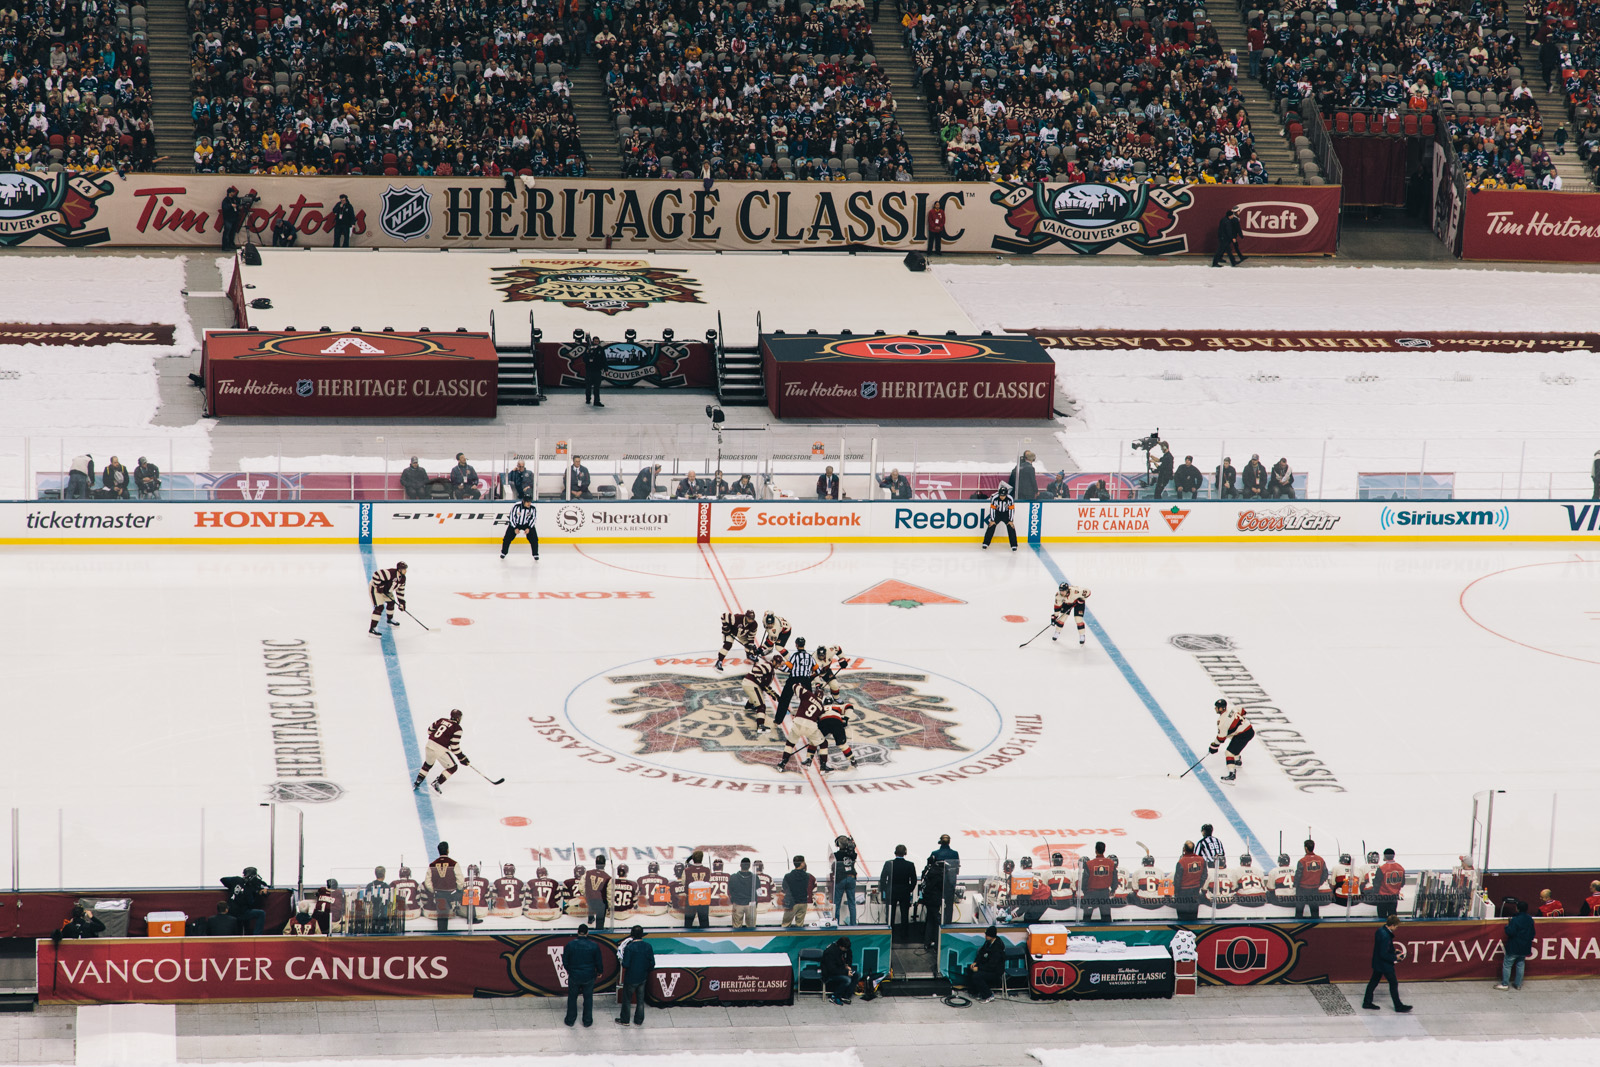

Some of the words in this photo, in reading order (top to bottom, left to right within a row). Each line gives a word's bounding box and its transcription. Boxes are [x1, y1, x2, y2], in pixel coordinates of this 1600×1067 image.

[75, 180, 91, 195] 14
[1009, 187, 1028, 205] 20
[1154, 191, 1171, 206] 14
[40, 211, 59, 224] BC
[133, 187, 210, 234] Tim
[390, 202, 423, 229] NHL
[443, 187, 722, 242] HERITAGE
[738, 189, 966, 245] CLASSIC
[1245, 209, 1298, 230] Kraft
[1487, 211, 1523, 236] Tim
[1525, 211, 1600, 238] Hortons
[1042, 221, 1117, 241] VANCOUVER
[1120, 221, 1138, 234] BC
[0, 331, 100, 341] Horton
[103, 331, 157, 341] Tim
[1034, 336, 1193, 348] CLASSIC
[1200, 337, 1392, 349] HERITAGE
[1436, 338, 1536, 349] Hortons
[1540, 338, 1594, 349] Tim
[217, 379, 242, 396] Tim
[243, 379, 293, 396] Hortons
[317, 379, 408, 397] HERITAGE
[412, 379, 488, 397] CLASSIC
[784, 381, 808, 397] Tim
[809, 381, 858, 398] Hortons
[881, 381, 969, 399] HERITAGE
[973, 381, 1047, 400] CLASSIC
[26, 511, 155, 529] ticketmaster
[194, 511, 334, 528] HONDA
[361, 503, 371, 537] Reebok
[591, 511, 669, 524] Sheraton
[699, 503, 709, 537] Reebok
[757, 511, 862, 527] Scotiabank
[894, 508, 991, 530] Reebok
[1030, 502, 1040, 536] Reebok
[1077, 507, 1098, 519] WE
[1100, 507, 1121, 519] ALL
[1123, 507, 1151, 519] PLAY
[1237, 510, 1285, 532] Coors
[1284, 516, 1341, 531] LIGHT
[1077, 520, 1100, 531] FOR
[1102, 520, 1149, 531] CANADA
[453, 590, 654, 600] HONDA
[262, 638, 313, 698] CLASSIC
[805, 704, 818, 717] 9
[433, 725, 448, 738] 8
[1014, 713, 1043, 736] TIM
[1196, 654, 1293, 726] HERITAGE
[1256, 727, 1347, 794] CLASSIC
[268, 700, 325, 778] HERITAGE
[528, 714, 617, 765] CLASSIC
[918, 736, 1038, 786] HORTONS
[617, 762, 803, 795] HERITAGE
[832, 779, 915, 795] NHL
[961, 828, 1128, 839] Scotiabank
[529, 846, 695, 862] CANADIAN
[435, 862, 450, 878] V
[590, 875, 604, 891] V
[711, 882, 728, 899] 29
[1054, 875, 1065, 891] 7
[1146, 876, 1156, 892] 6
[1242, 875, 1260, 889] 25
[1283, 875, 1293, 889] 4
[504, 885, 515, 902] 3
[537, 887, 552, 904] 17
[614, 890, 631, 907] 36
[695, 891, 703, 899] G
[161, 924, 171, 933] G
[1045, 936, 1055, 946] G
[58, 956, 275, 985] VANCOUVER
[284, 955, 450, 981] CANUCKS
[1101, 972, 1136, 981] HERITAGE
[1137, 971, 1166, 980] CLASSIC
[720, 980, 756, 990] HERITAGE
[757, 980, 787, 989] CLASSIC
